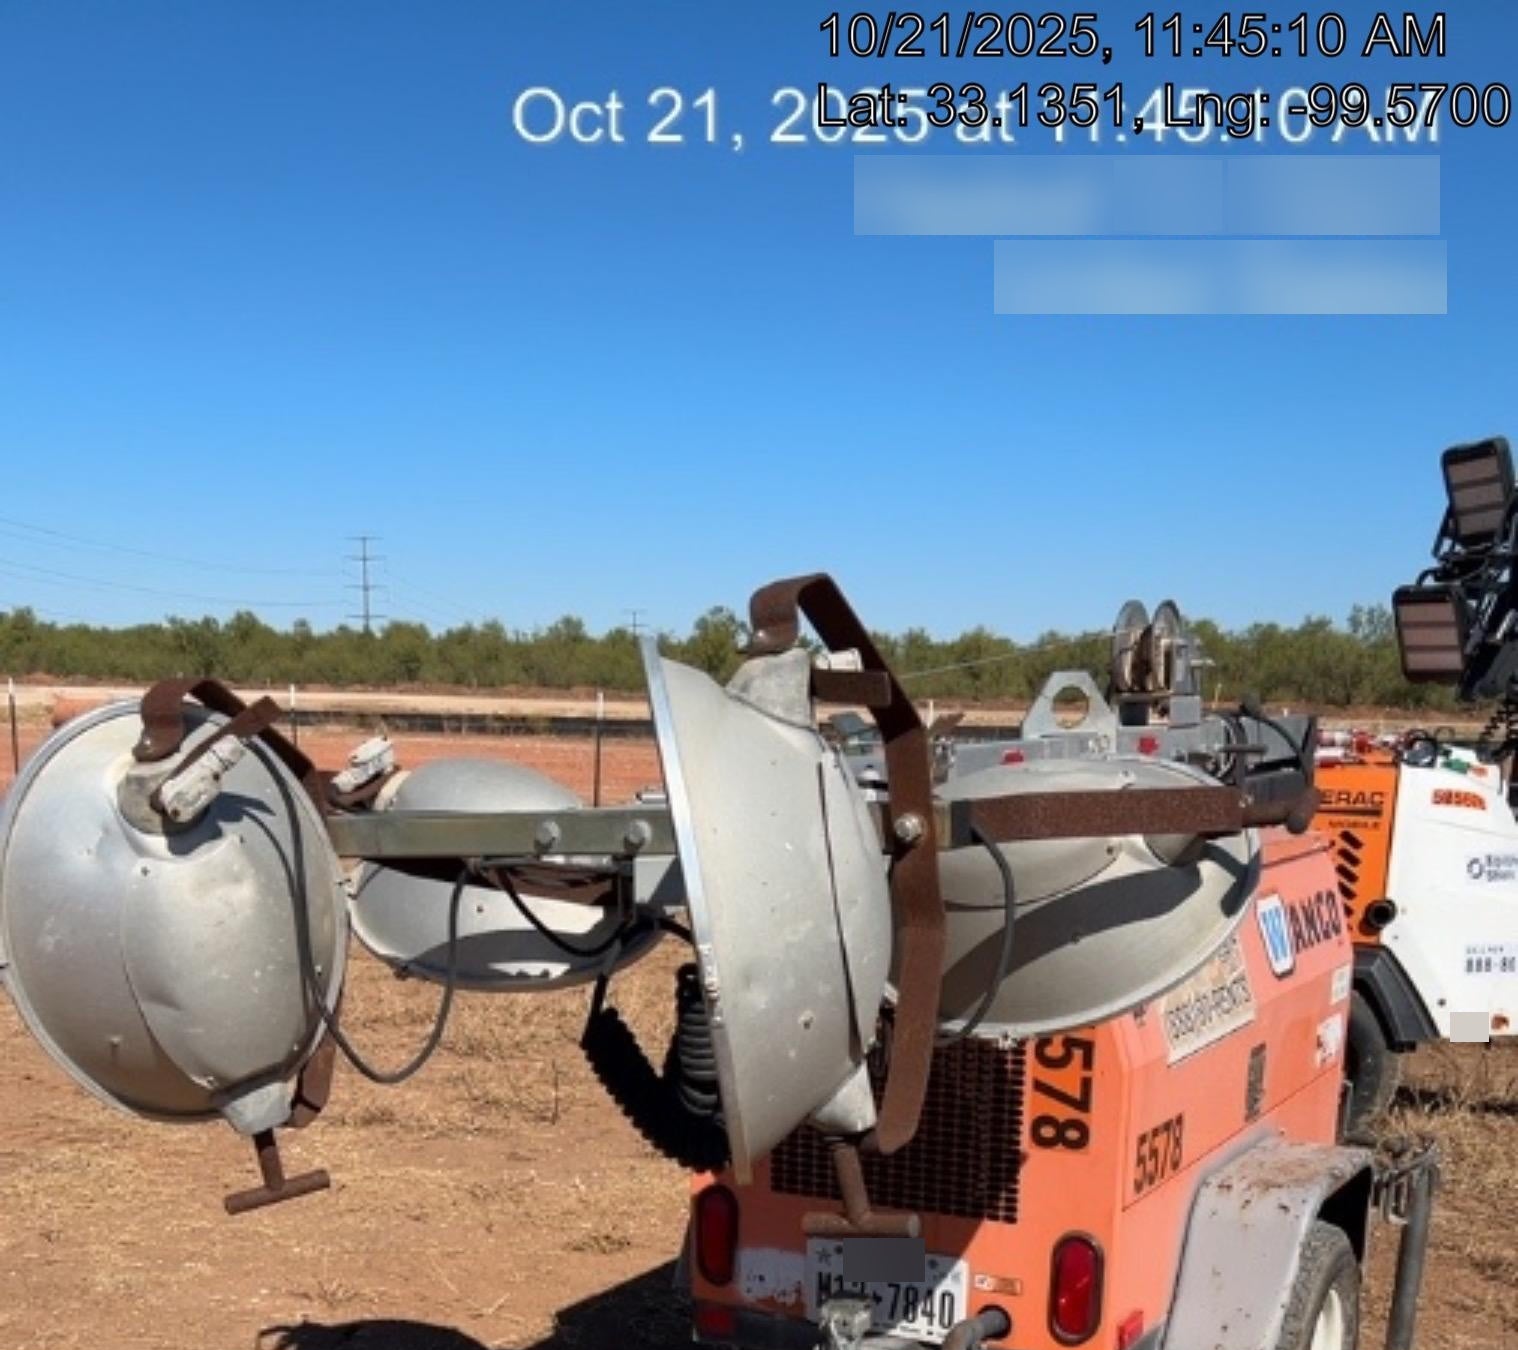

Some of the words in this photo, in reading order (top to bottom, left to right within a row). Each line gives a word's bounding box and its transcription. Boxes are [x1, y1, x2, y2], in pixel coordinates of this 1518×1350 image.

[1320, 791, 1384, 806] ERAC
[1258, 889, 1341, 963] WANCO
[1031, 1026, 1095, 1150] 578
[1134, 1112, 1184, 1194] 5578
[888, 1283, 956, 1329] 7840
